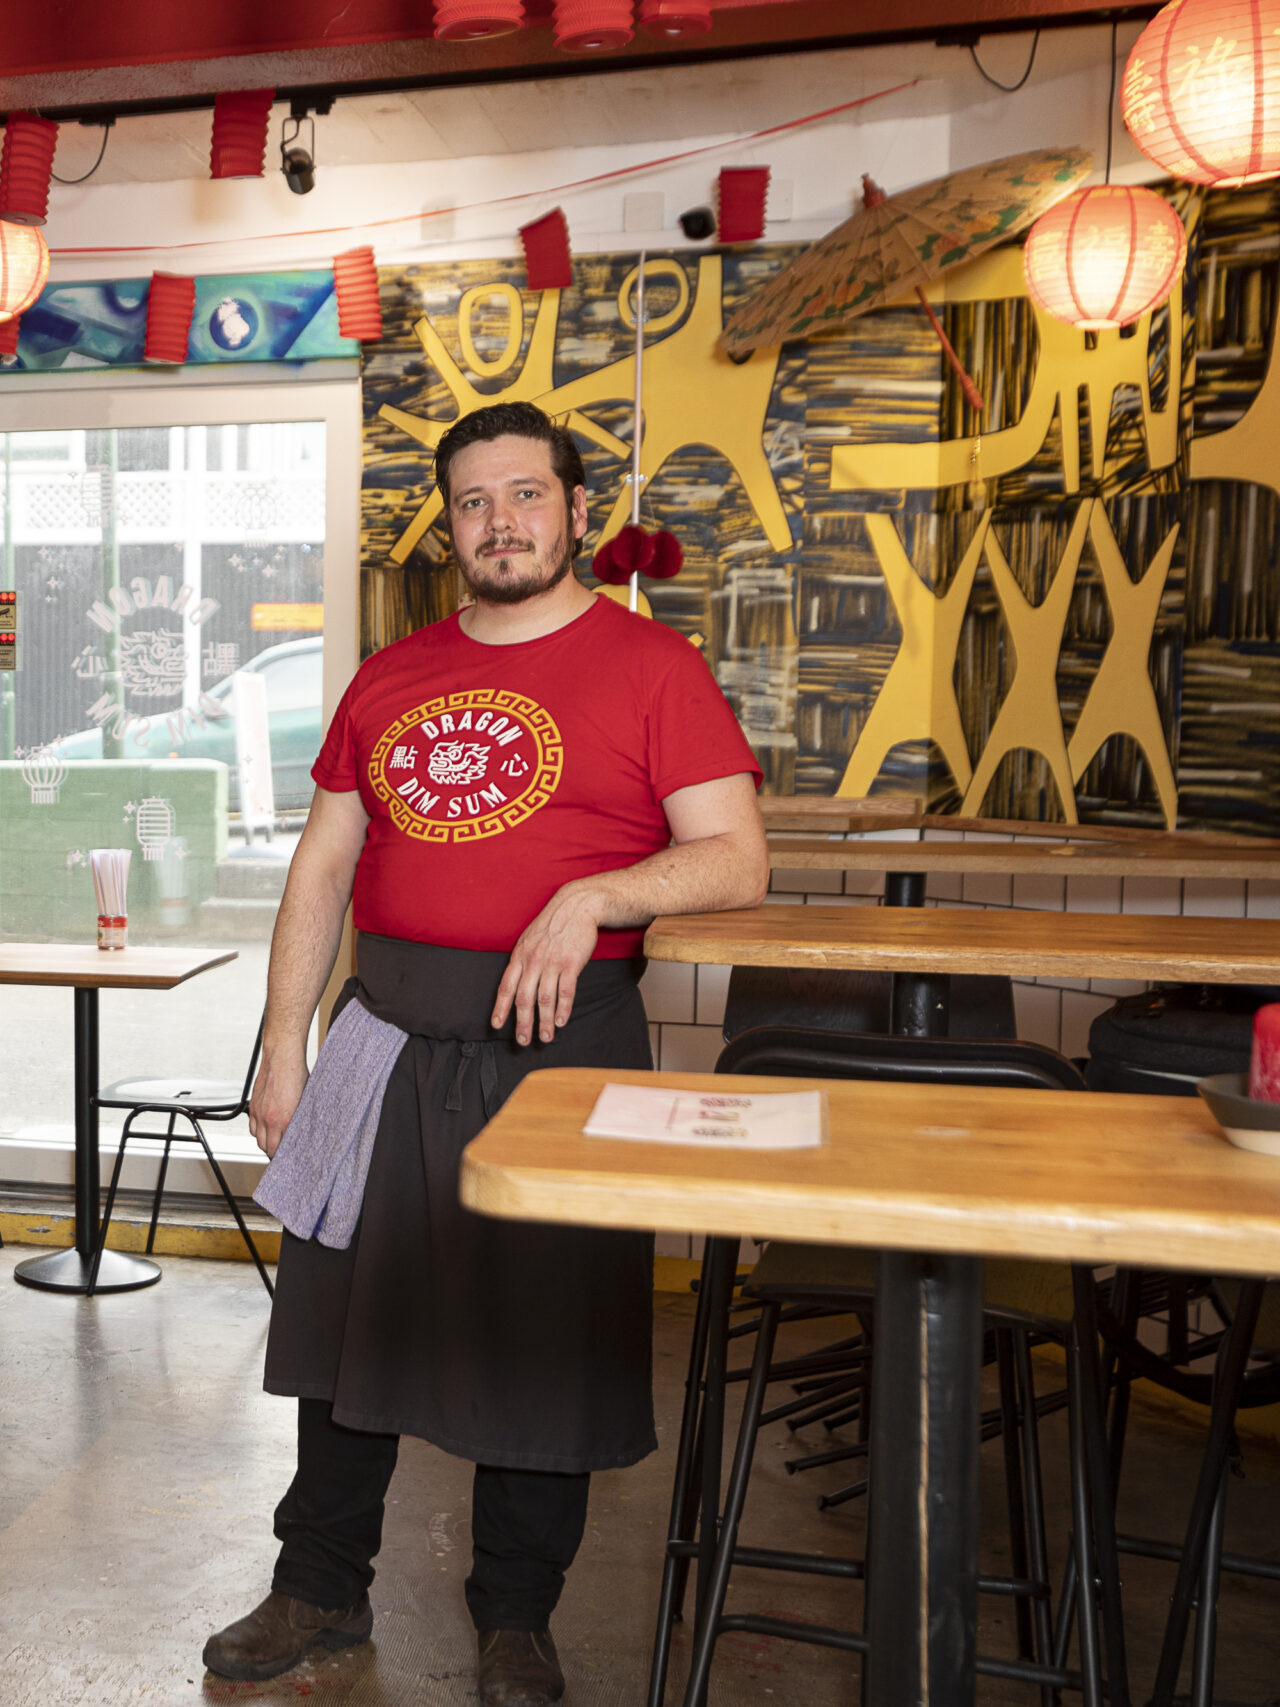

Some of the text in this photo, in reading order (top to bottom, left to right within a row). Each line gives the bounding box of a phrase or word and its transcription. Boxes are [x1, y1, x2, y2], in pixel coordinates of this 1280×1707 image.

[421, 711, 523, 747] DRAGON
[390, 745, 529, 777] 點 心
[396, 777, 507, 818] DIM SUM
